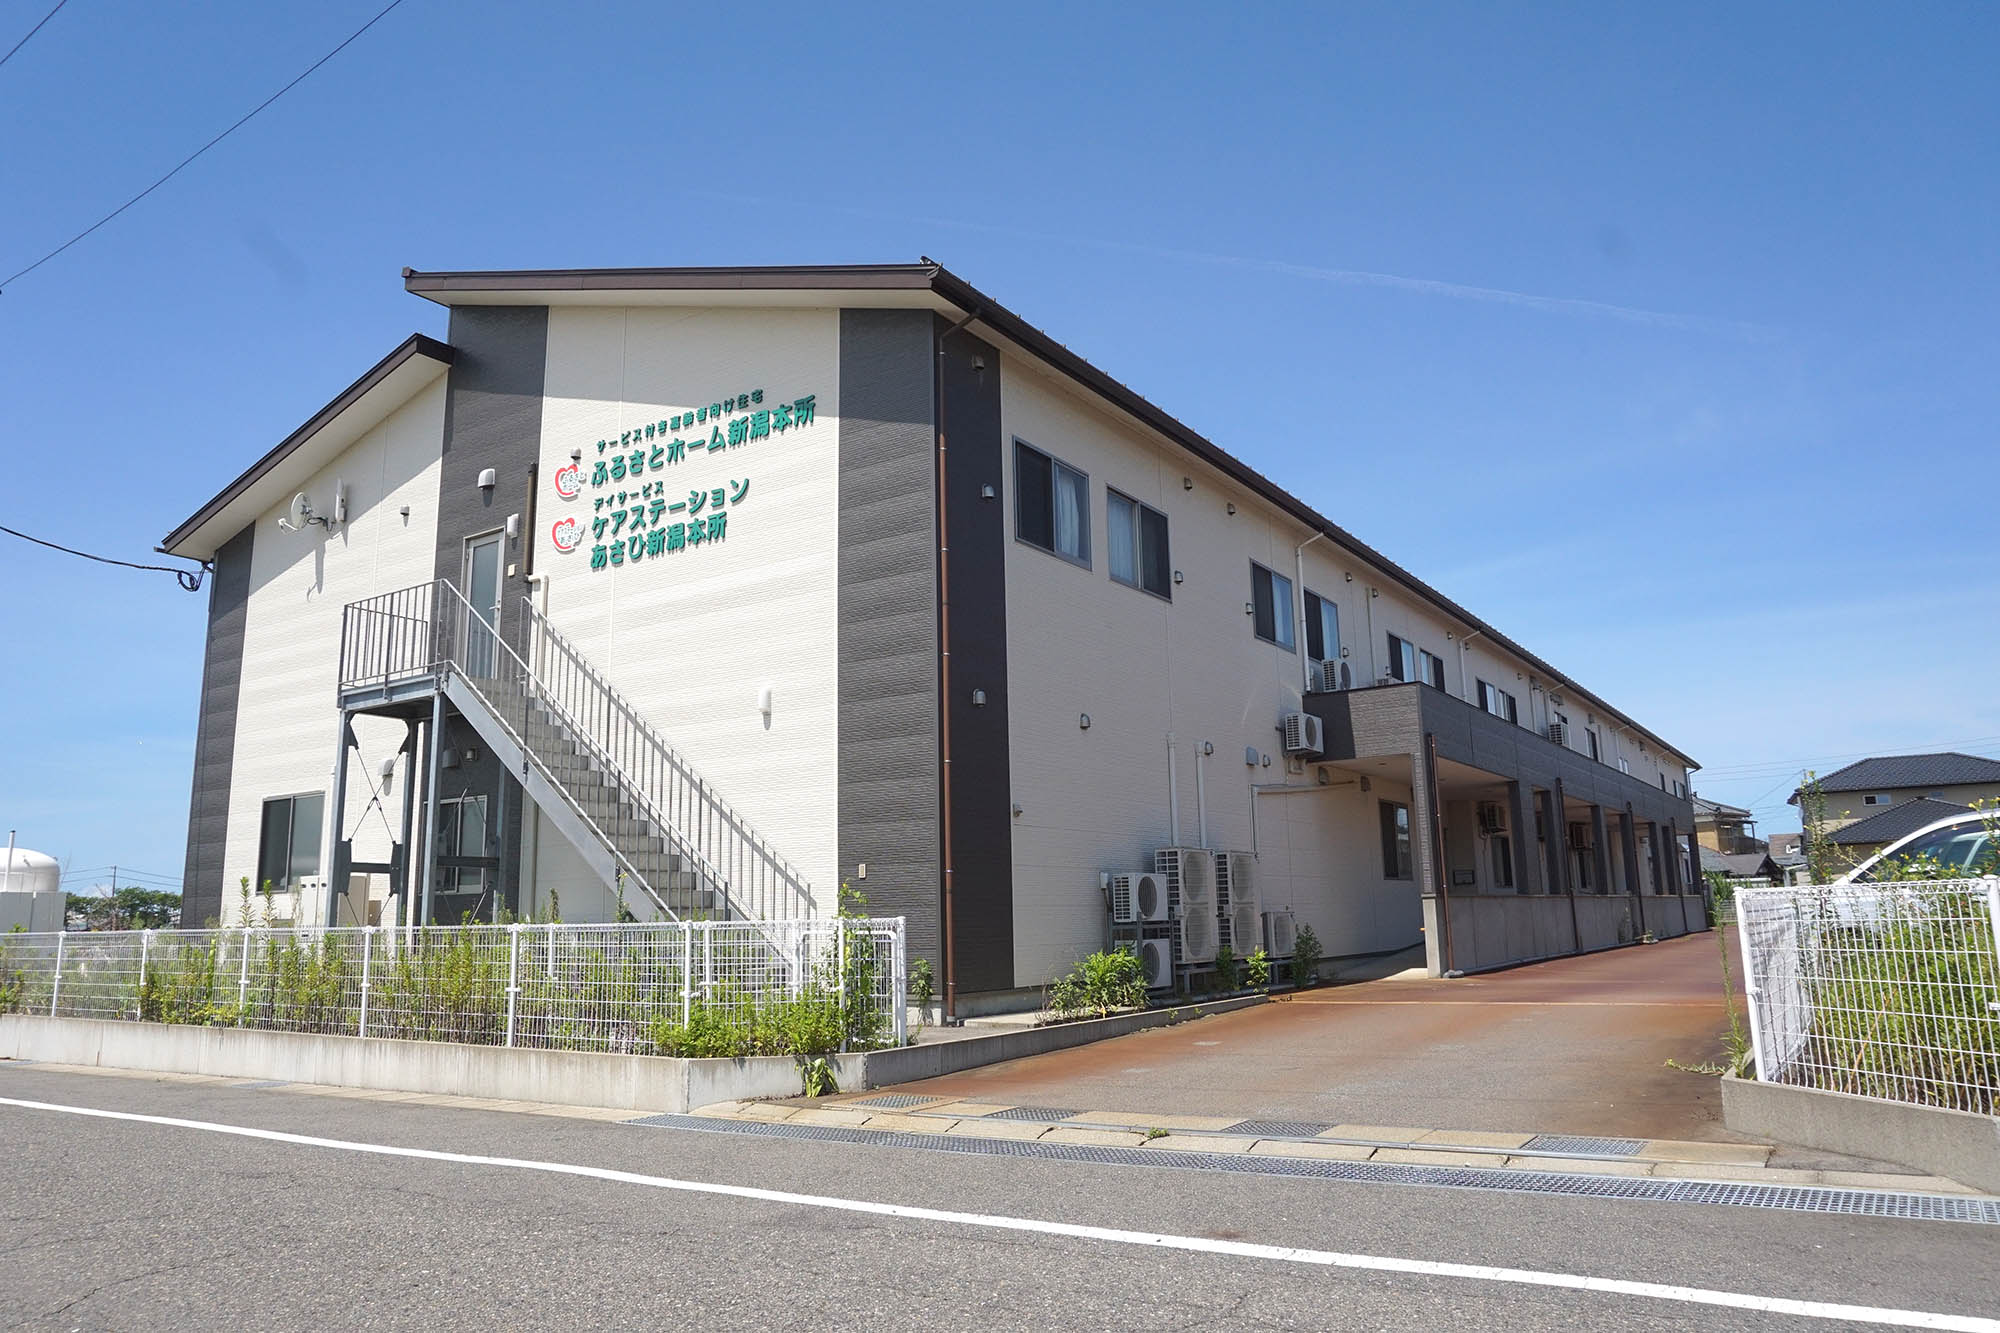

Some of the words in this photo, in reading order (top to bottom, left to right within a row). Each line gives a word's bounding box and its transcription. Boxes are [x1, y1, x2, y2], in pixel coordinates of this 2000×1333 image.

[591, 395, 815, 486] ふるさとホーム新潟本所
[597, 389, 763, 452] サービス付き高齢者向け住宅
[591, 478, 749, 539] ケアステーション
[590, 512, 727, 569] あさひ新潟本所
